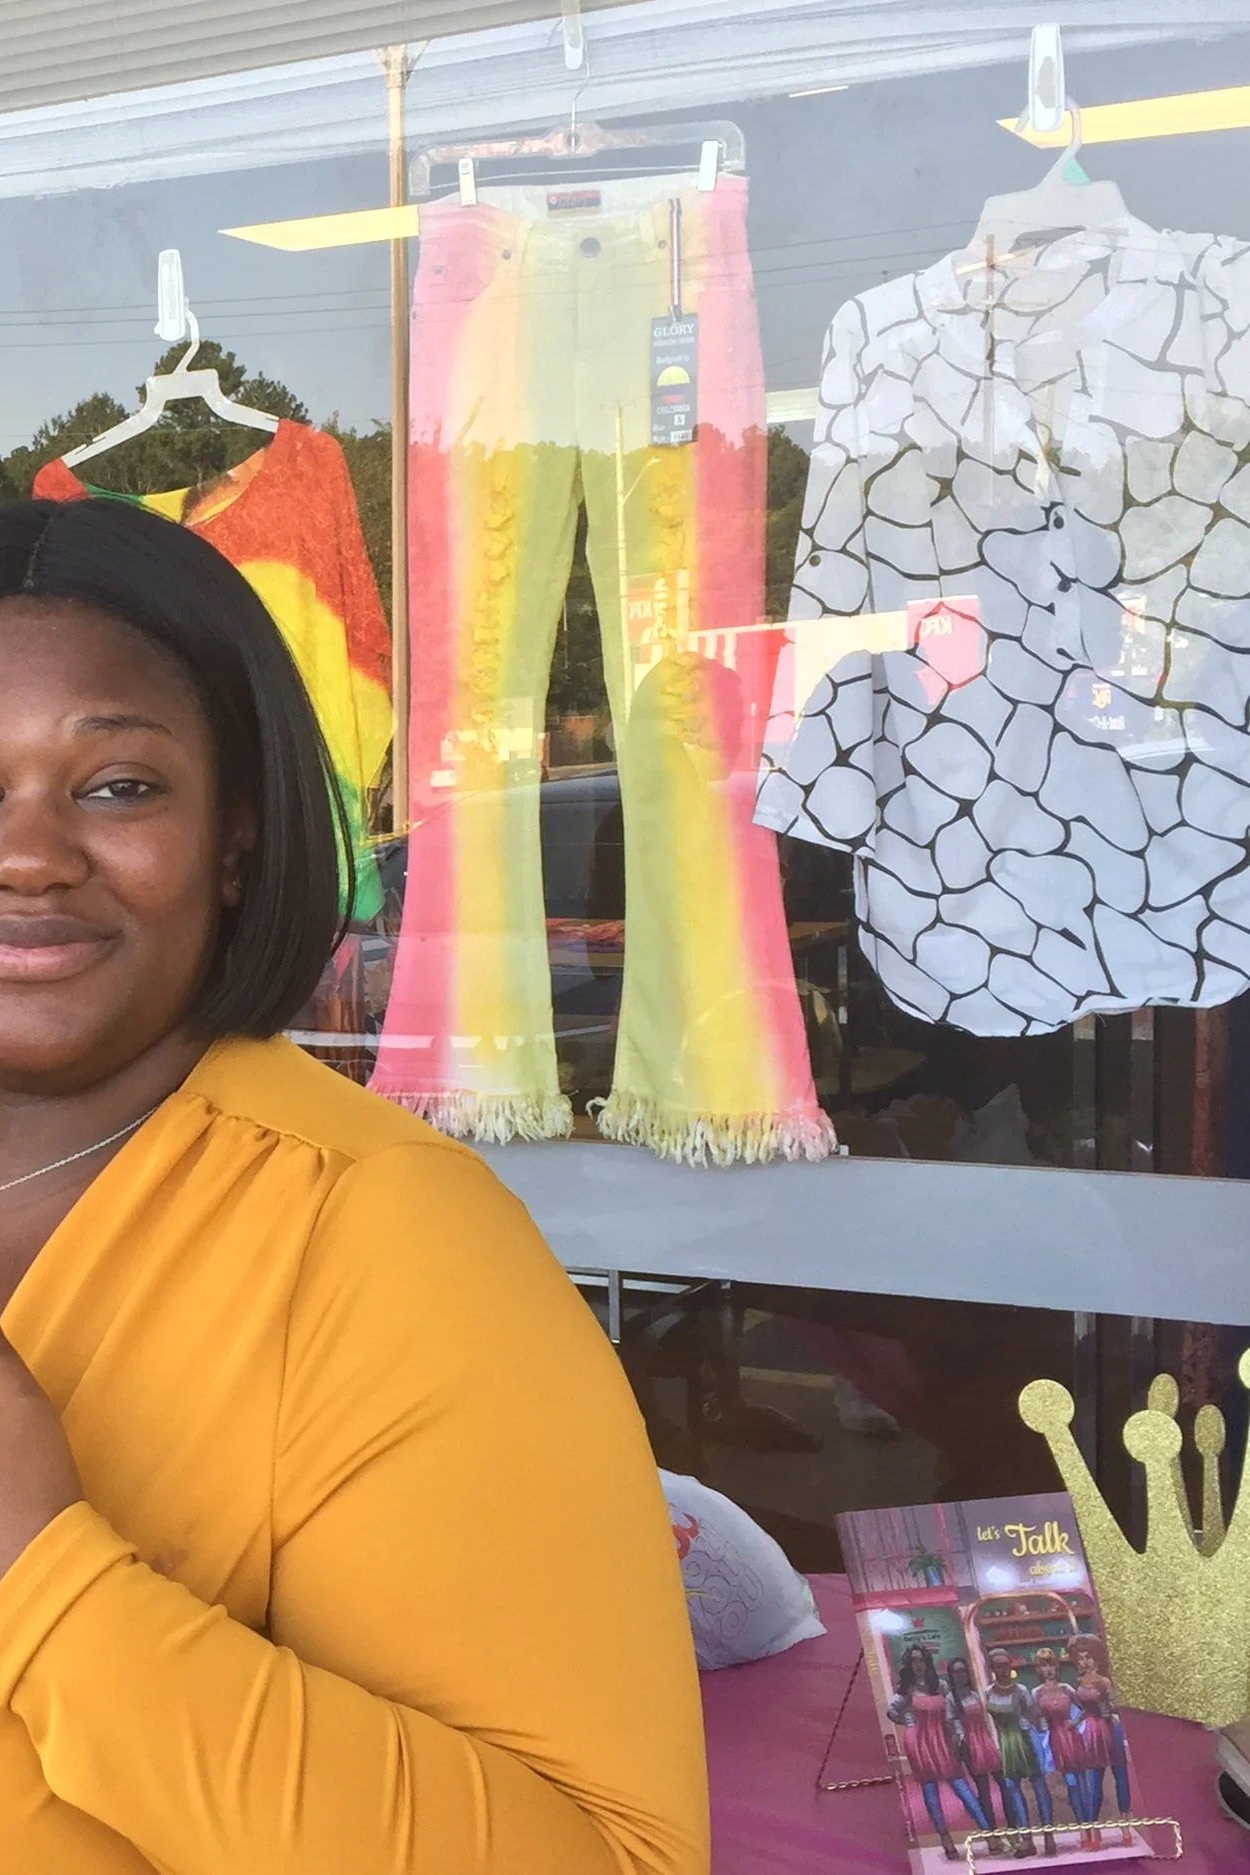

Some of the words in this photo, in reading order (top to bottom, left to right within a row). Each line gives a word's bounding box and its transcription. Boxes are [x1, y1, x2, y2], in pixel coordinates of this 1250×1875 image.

[653, 323, 695, 337] GLORY
[977, 1525, 1000, 1541] let's
[1004, 1521, 1075, 1557] Talk
